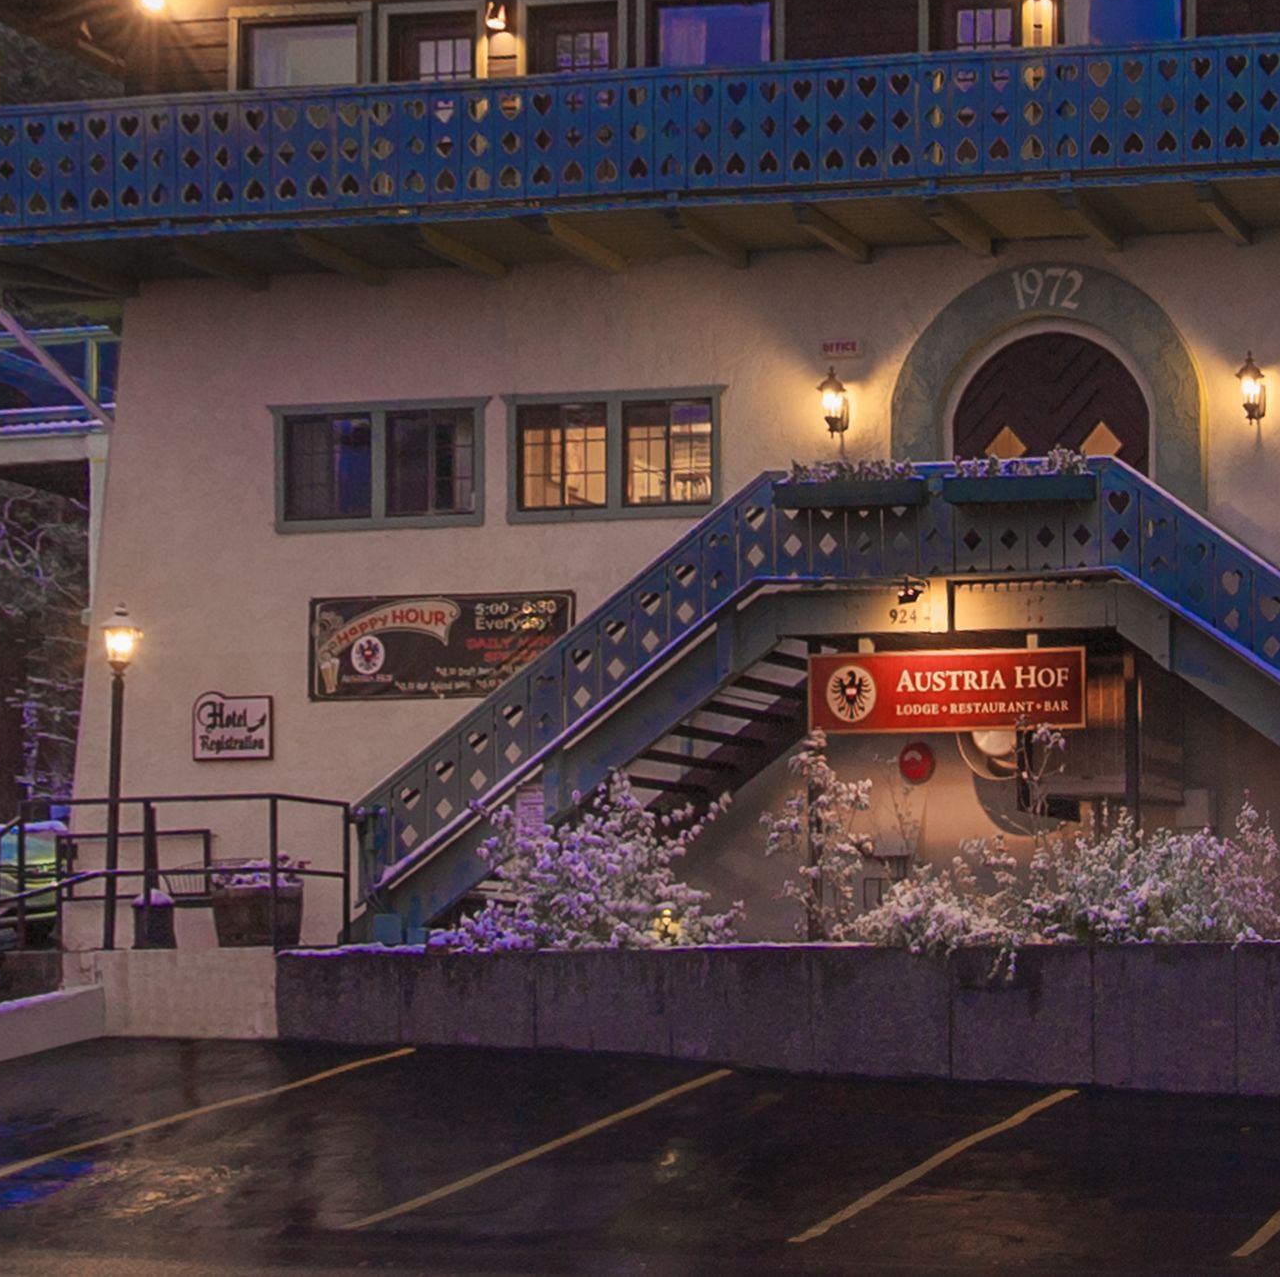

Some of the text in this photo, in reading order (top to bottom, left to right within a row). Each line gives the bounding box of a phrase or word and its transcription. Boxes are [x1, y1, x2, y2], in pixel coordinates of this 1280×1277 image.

[1012, 267, 1084, 311] 1972
[391, 607, 447, 627] HOUR
[474, 602, 509, 617] 5:00
[895, 665, 1070, 693] AUSTRIA HOF
[197, 701, 248, 734] Hotel
[895, 699, 1070, 717] LODGE RESTAURANT BAR
[199, 735, 265, 755] Registration
